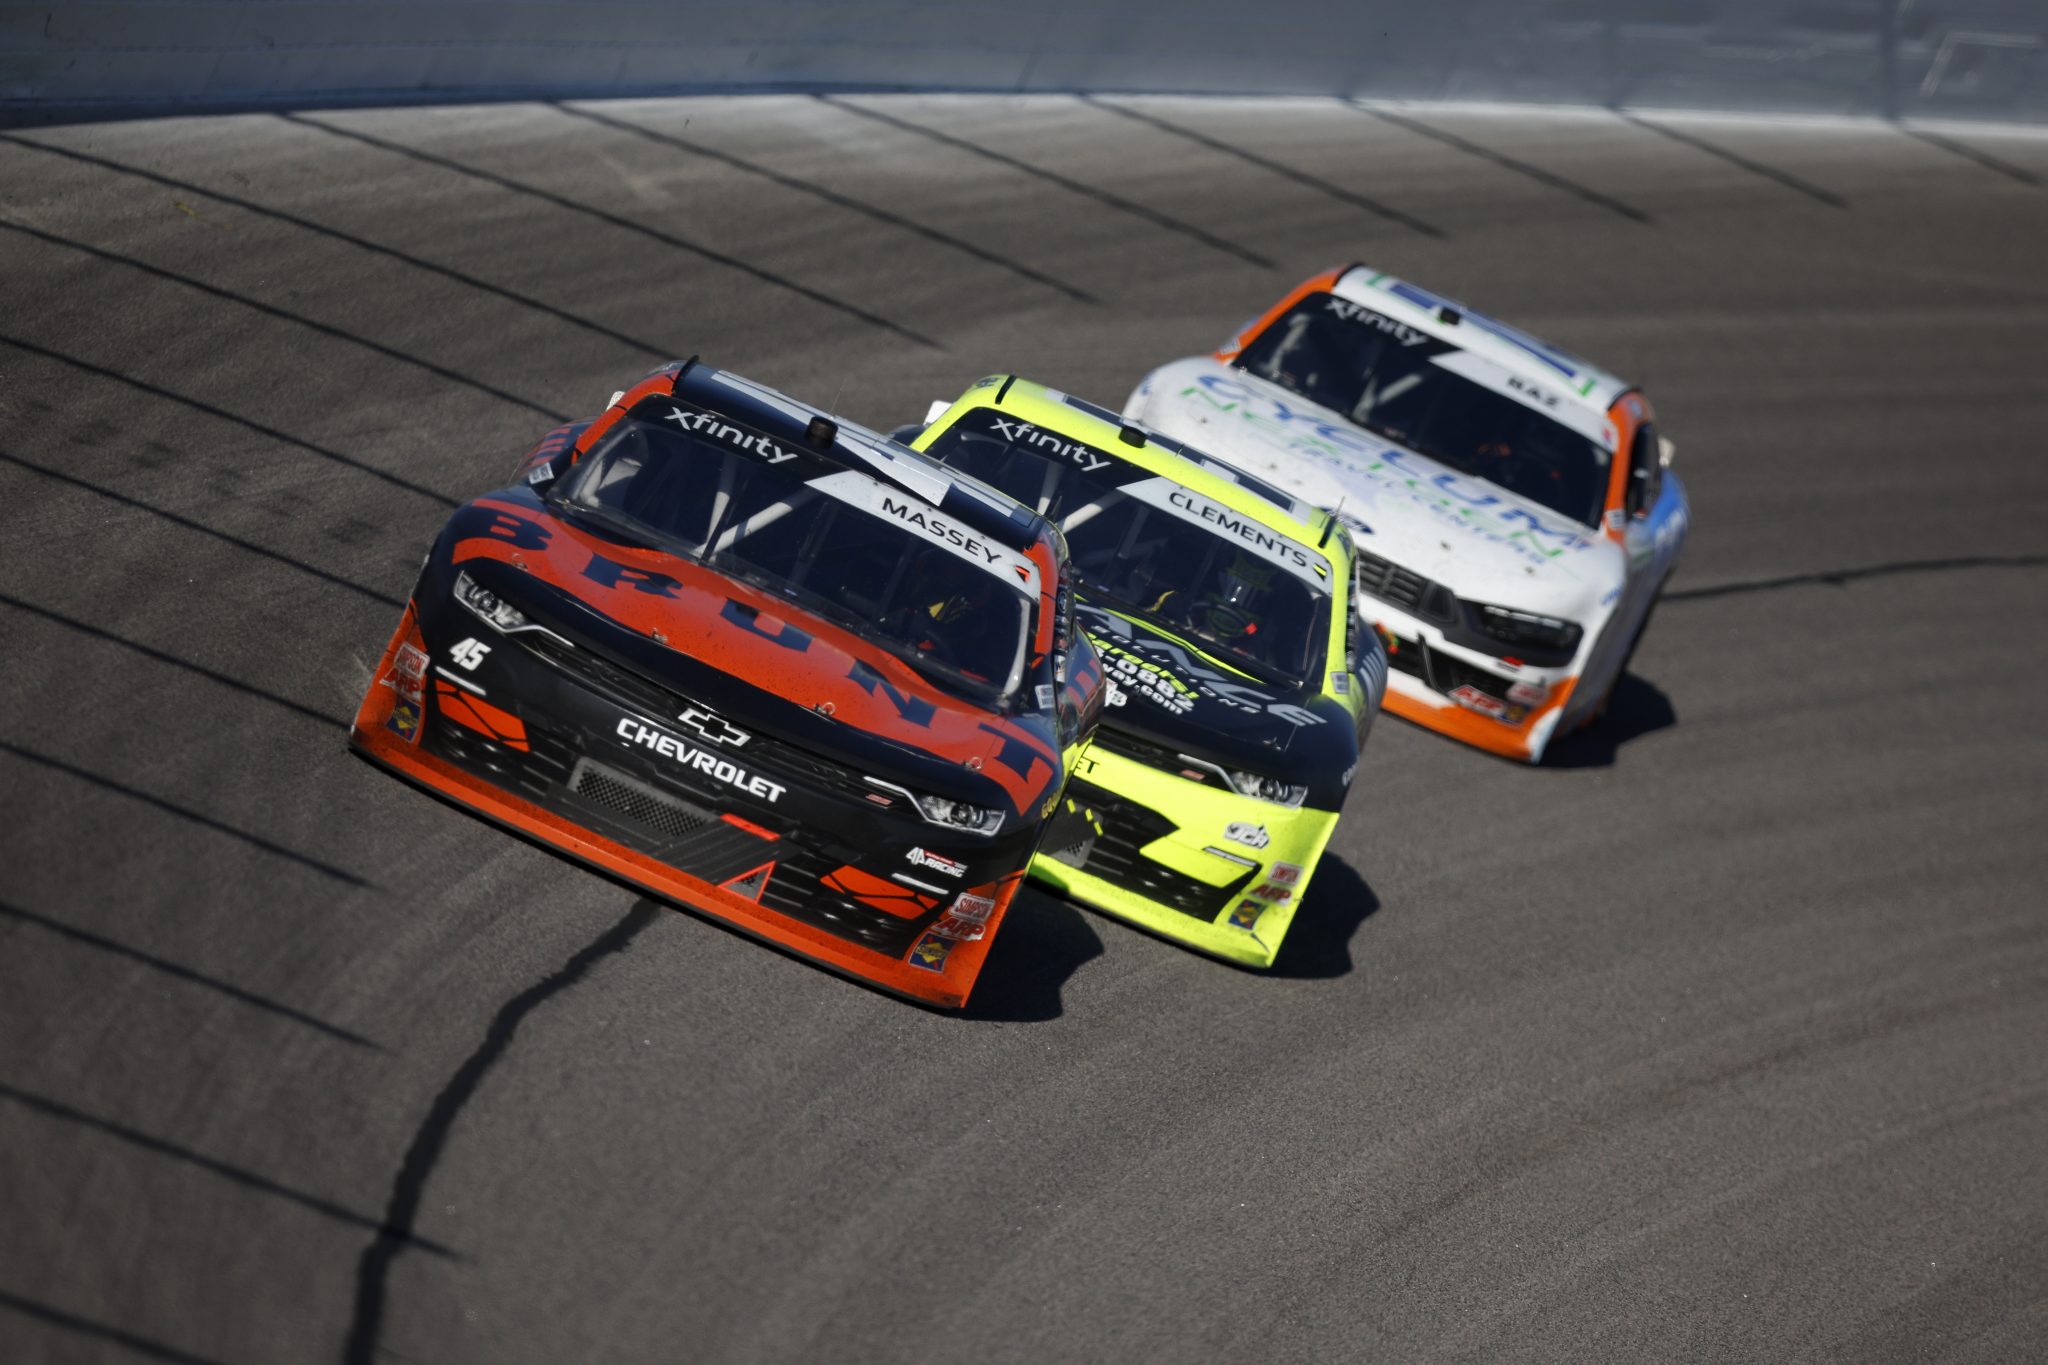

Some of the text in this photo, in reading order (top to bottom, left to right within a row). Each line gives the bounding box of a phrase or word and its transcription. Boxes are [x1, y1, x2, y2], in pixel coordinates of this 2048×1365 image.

[664, 406, 799, 464] xfinity
[990, 417, 1111, 472] xfinity
[882, 497, 1003, 564] MASSEY
[1169, 491, 1307, 567] CLEMENTS
[449, 637, 492, 671] 45
[617, 718, 786, 802] CHEVROLET
